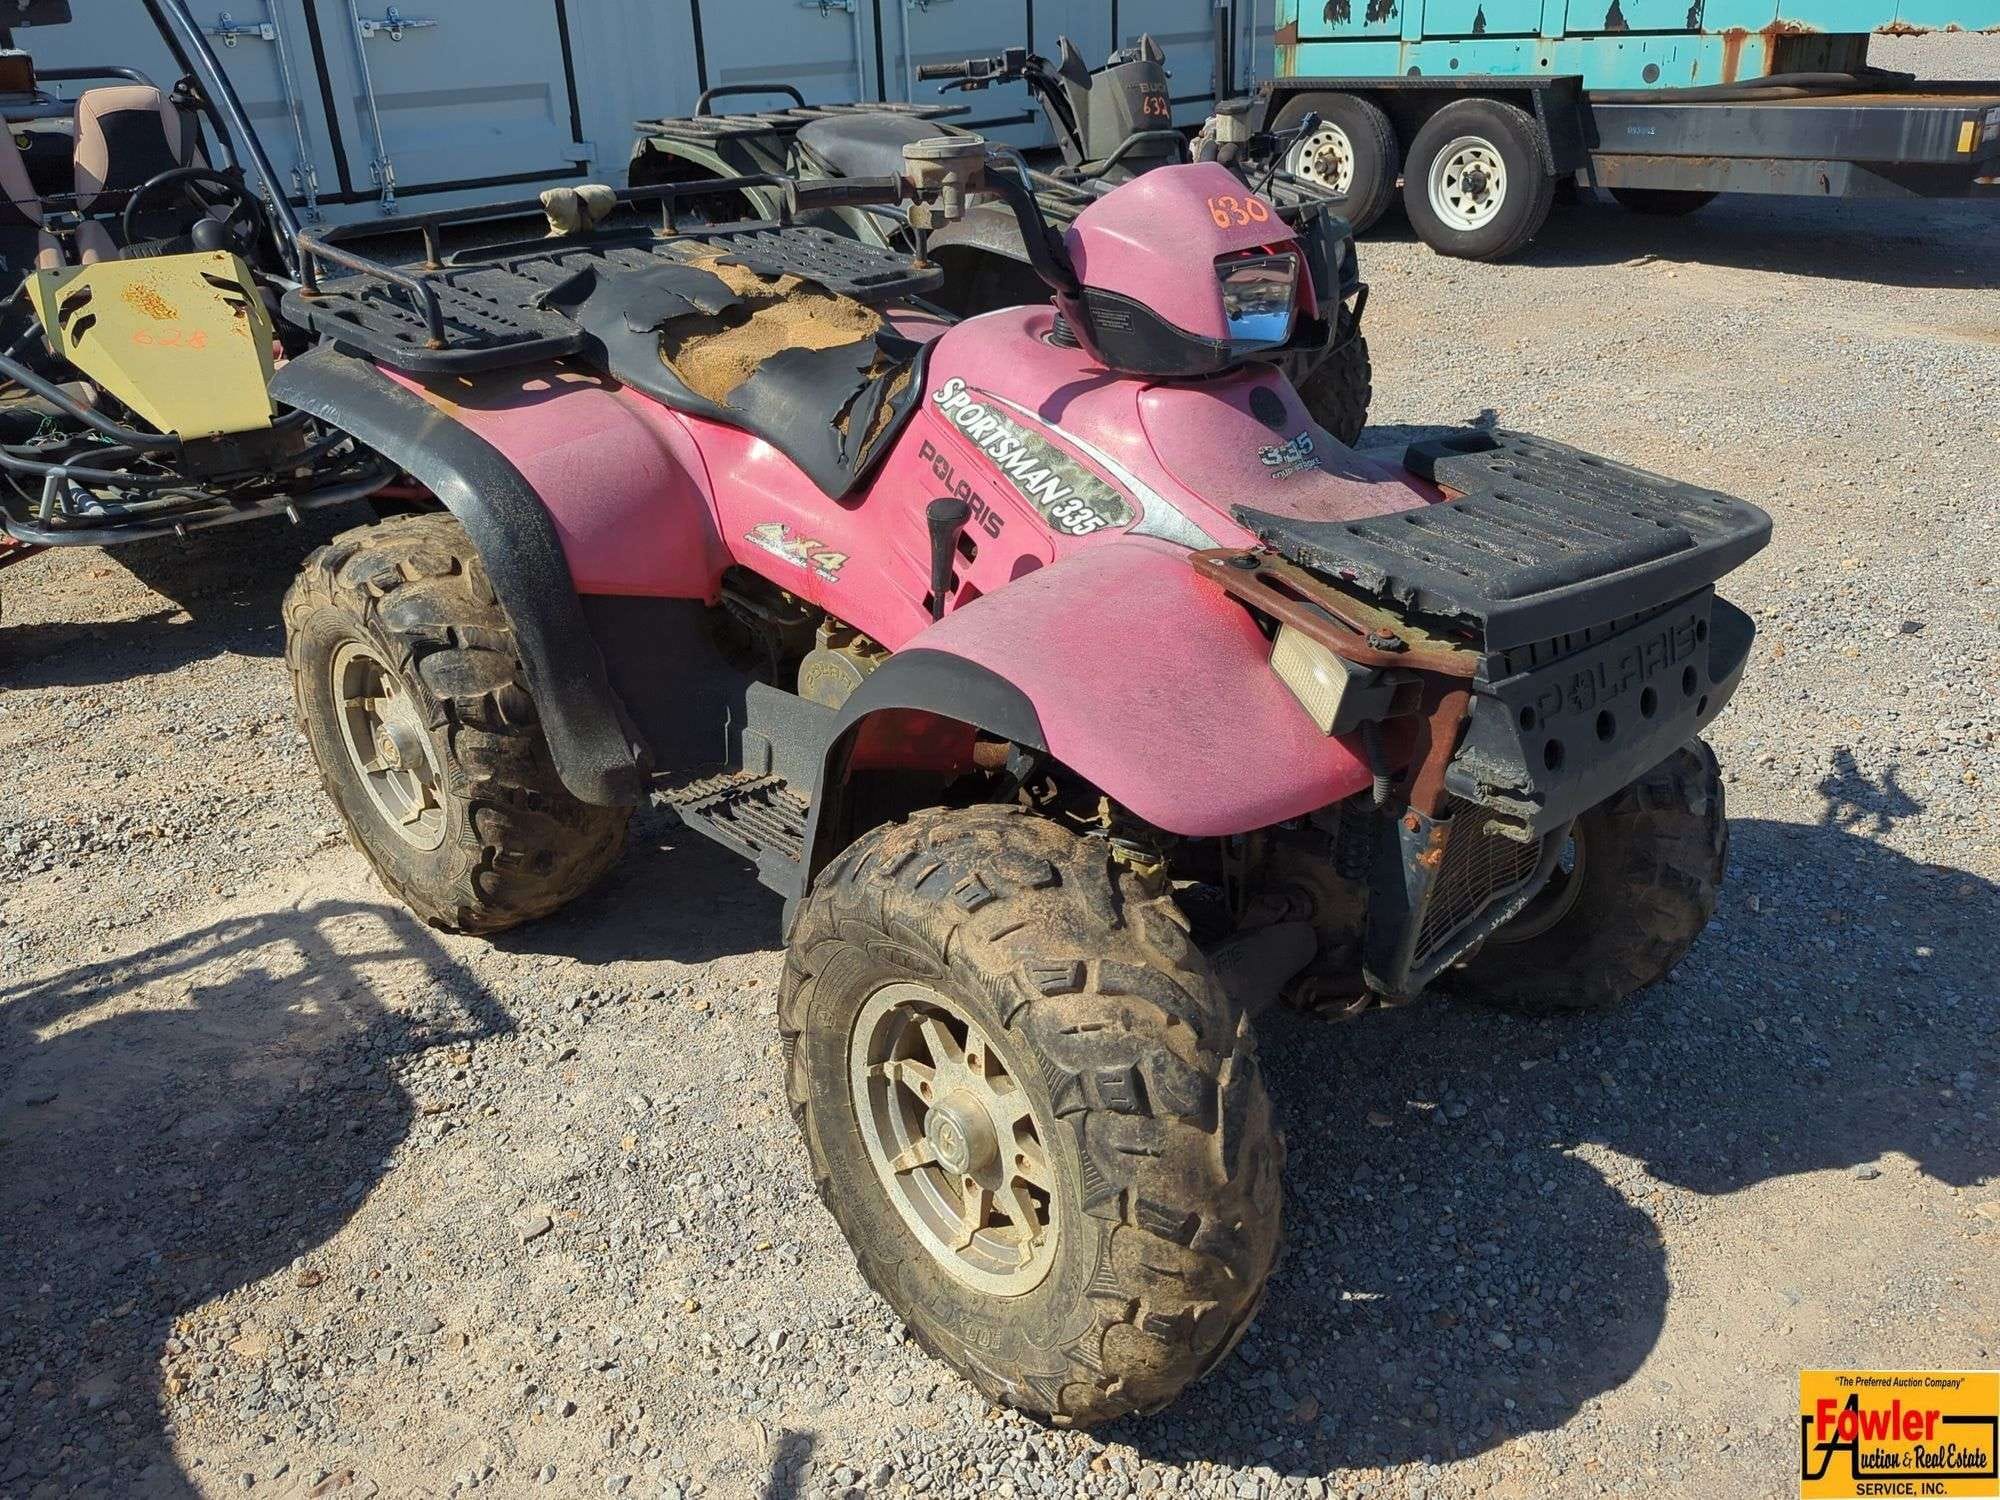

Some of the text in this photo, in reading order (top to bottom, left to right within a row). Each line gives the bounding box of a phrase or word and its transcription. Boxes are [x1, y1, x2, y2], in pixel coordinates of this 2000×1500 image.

[1208, 196, 1268, 229] 630
[918, 439, 1005, 539] POLARIS
[932, 376, 1109, 536] SPORTSMAN 335
[1257, 431, 1313, 465] 335
[1538, 613, 1698, 729] POLARIS
